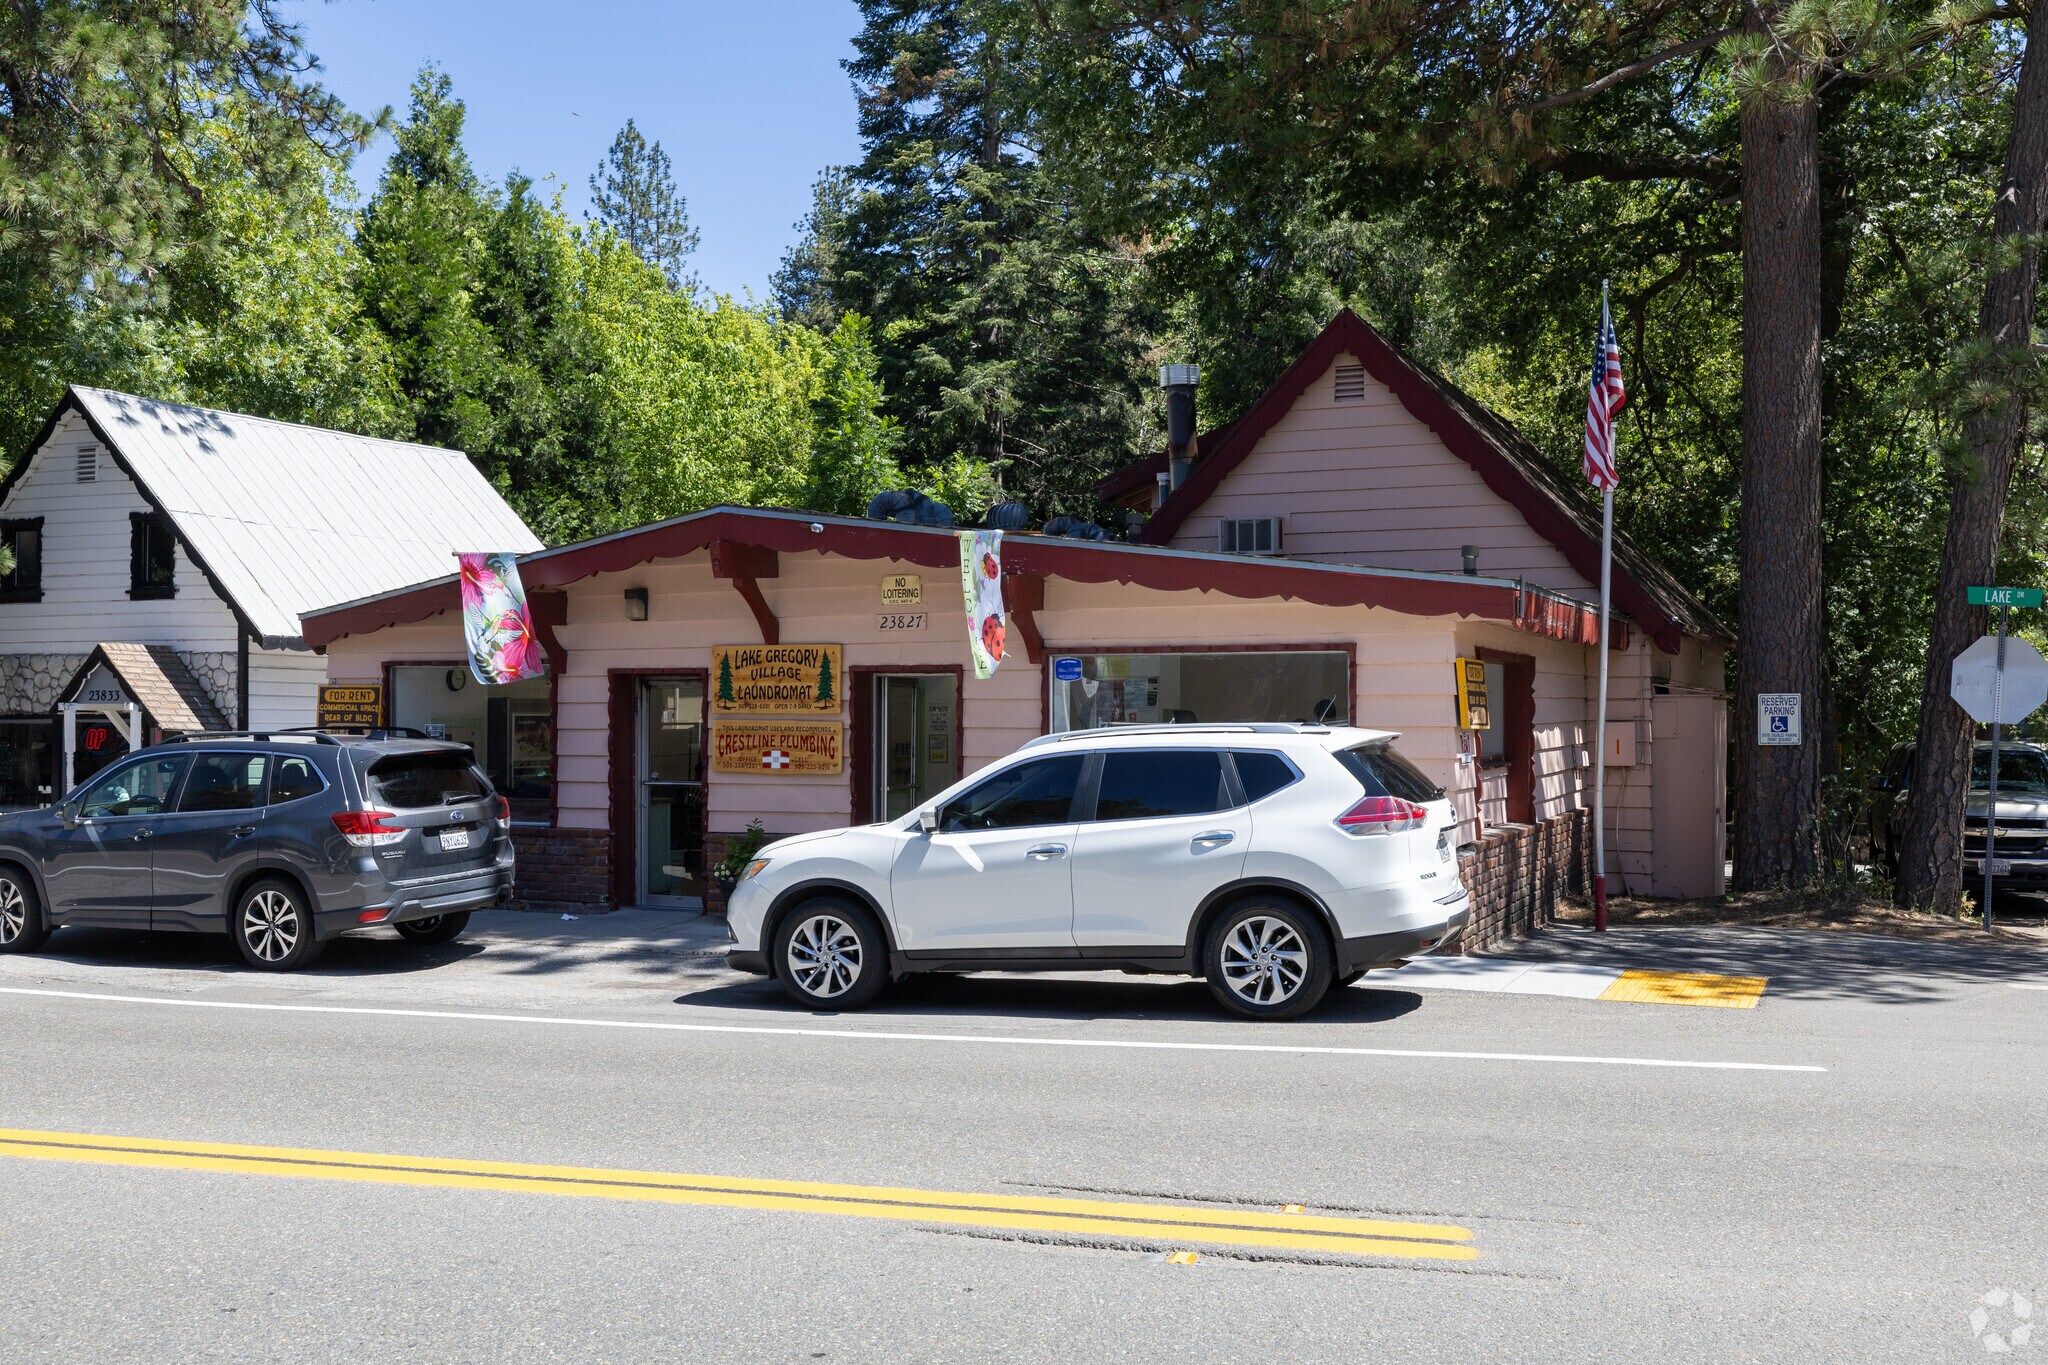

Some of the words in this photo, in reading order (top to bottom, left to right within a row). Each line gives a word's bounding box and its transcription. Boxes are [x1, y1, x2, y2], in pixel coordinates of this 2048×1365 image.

[895, 577, 906, 588] NO
[883, 588, 919, 599] LOITERING
[1985, 589, 2012, 604] LAKE
[880, 614, 923, 629] 23827
[735, 650, 762, 670] LAKE
[766, 649, 818, 668] GREGORY
[751, 667, 801, 681] VILLAGE
[88, 690, 120, 701] 23833
[329, 691, 345, 701] FOR
[348, 690, 371, 701] RENT
[738, 685, 813, 700] LAUNDROMAT
[1761, 697, 1797, 706] RESERVED
[319, 703, 358, 711] COMMERCIAL
[360, 704, 380, 712] SPACE
[1764, 706, 1794, 715] PARKING
[324, 714, 341, 722] REAR
[343, 714, 352, 722] OF
[355, 714, 372, 722] BLDG
[718, 733, 776, 758] CRESTLINE
[780, 734, 835, 760] PLUMBING
